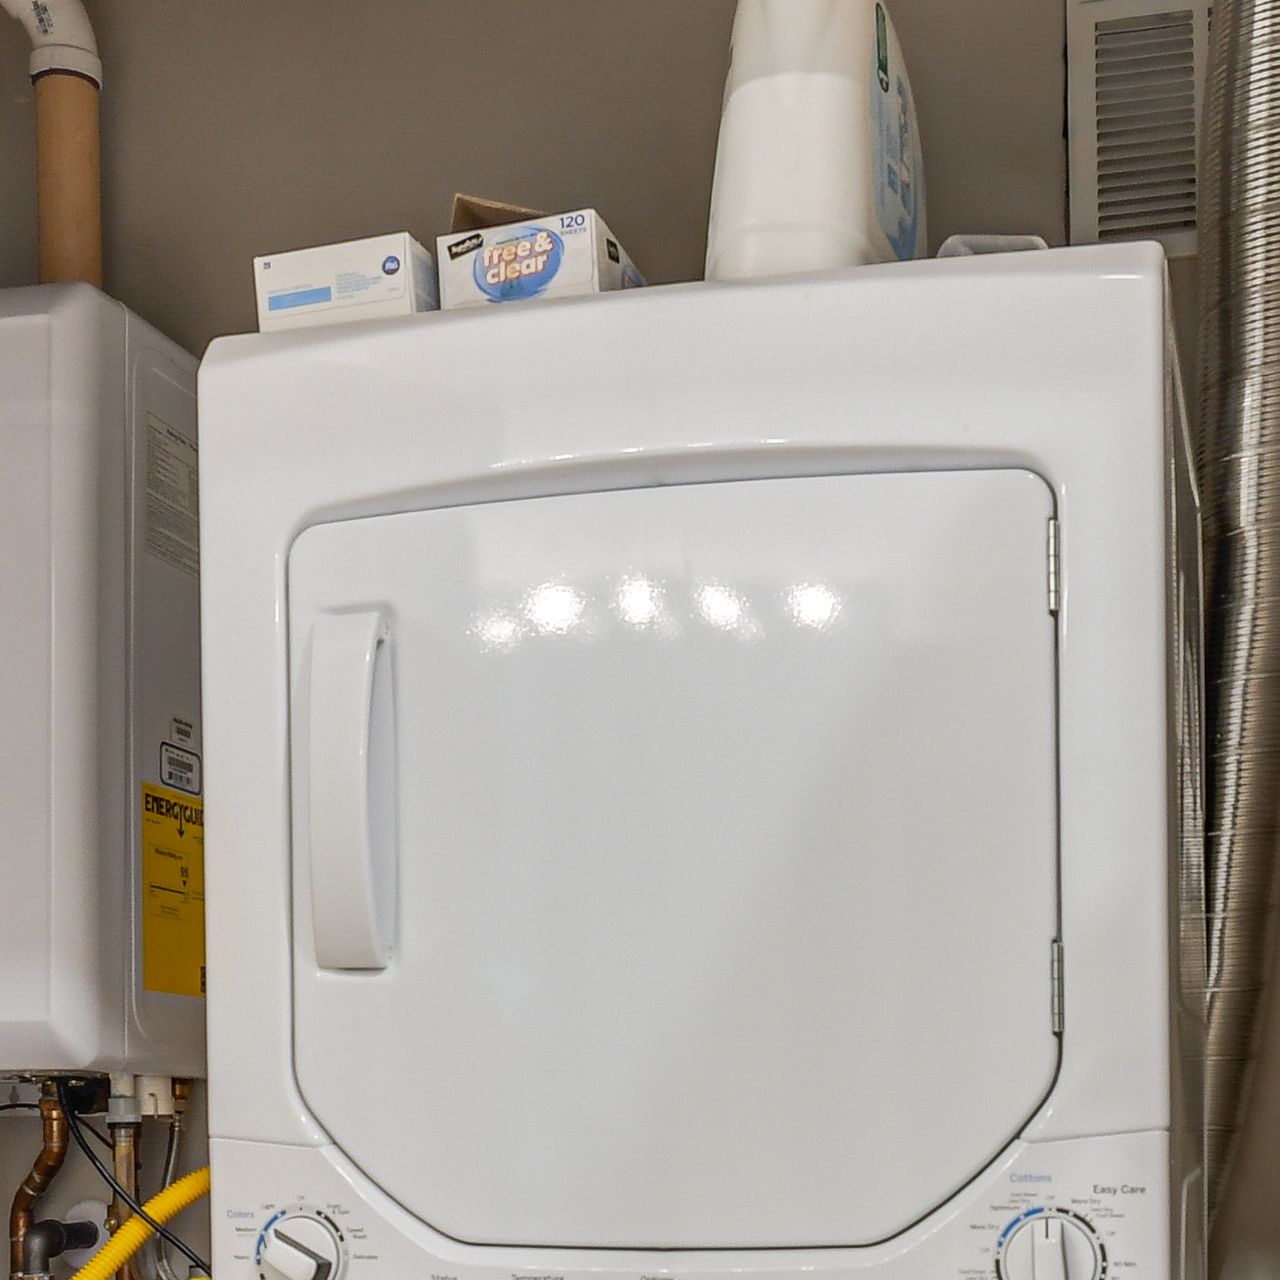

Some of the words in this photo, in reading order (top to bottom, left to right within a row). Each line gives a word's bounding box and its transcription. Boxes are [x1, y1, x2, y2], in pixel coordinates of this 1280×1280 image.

[559, 214, 586, 229] 120
[482, 240, 532, 267] free
[534, 230, 555, 253] &
[485, 252, 549, 286] clear
[1009, 1174, 1052, 1184] Cottons
[1092, 1184, 1119, 1196] Easy
[1120, 1184, 1147, 1194] Care
[226, 1209, 255, 1219] Colors
